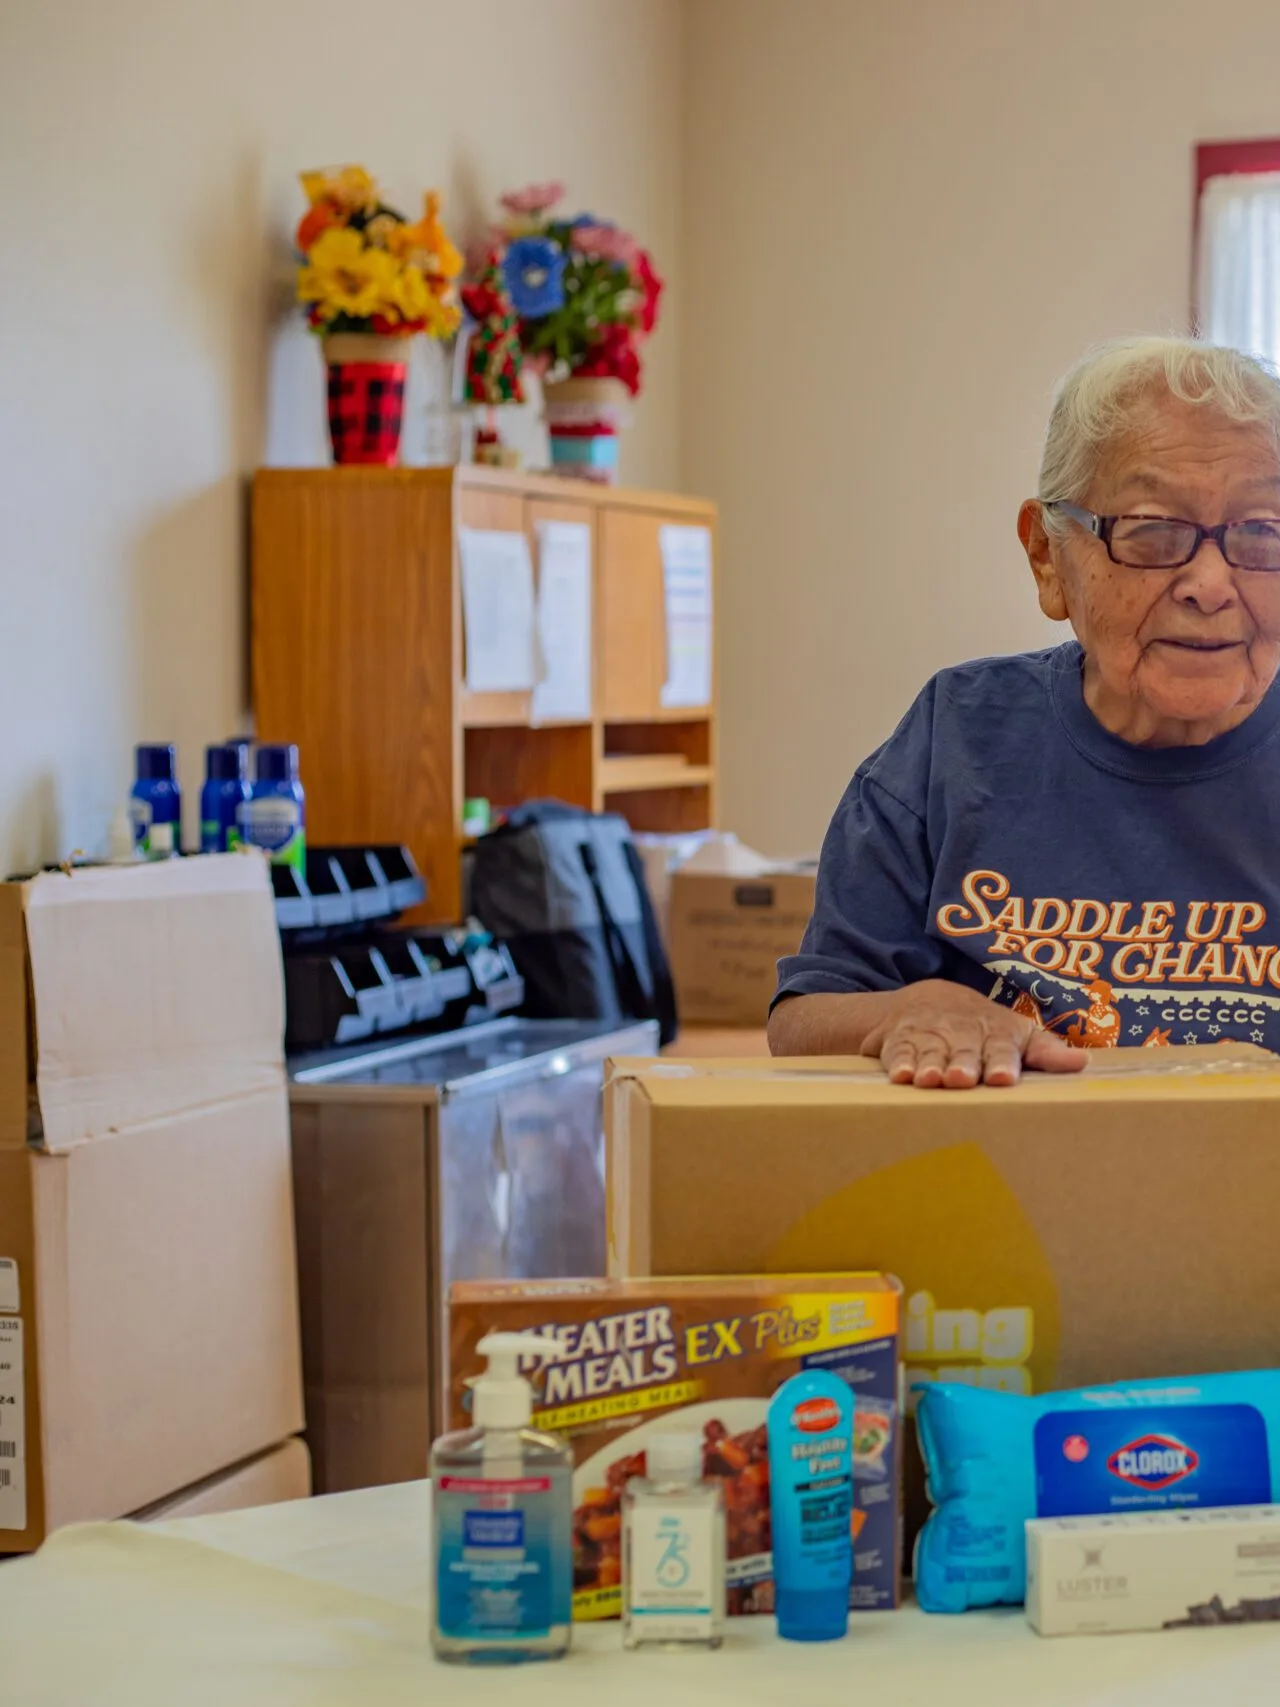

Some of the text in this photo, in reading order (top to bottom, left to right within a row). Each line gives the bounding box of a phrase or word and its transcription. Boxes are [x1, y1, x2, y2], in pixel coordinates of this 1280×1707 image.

[936, 869, 1266, 945] SADDLE UP
[988, 930, 1103, 981] FOR
[521, 1305, 674, 1370] HEATER
[685, 1317, 742, 1364] EX
[751, 1307, 820, 1348] Plus
[545, 1343, 677, 1404] MEALS
[1117, 1449, 1188, 1477] CLOROX
[1057, 1577, 1128, 1594] LUSTER
